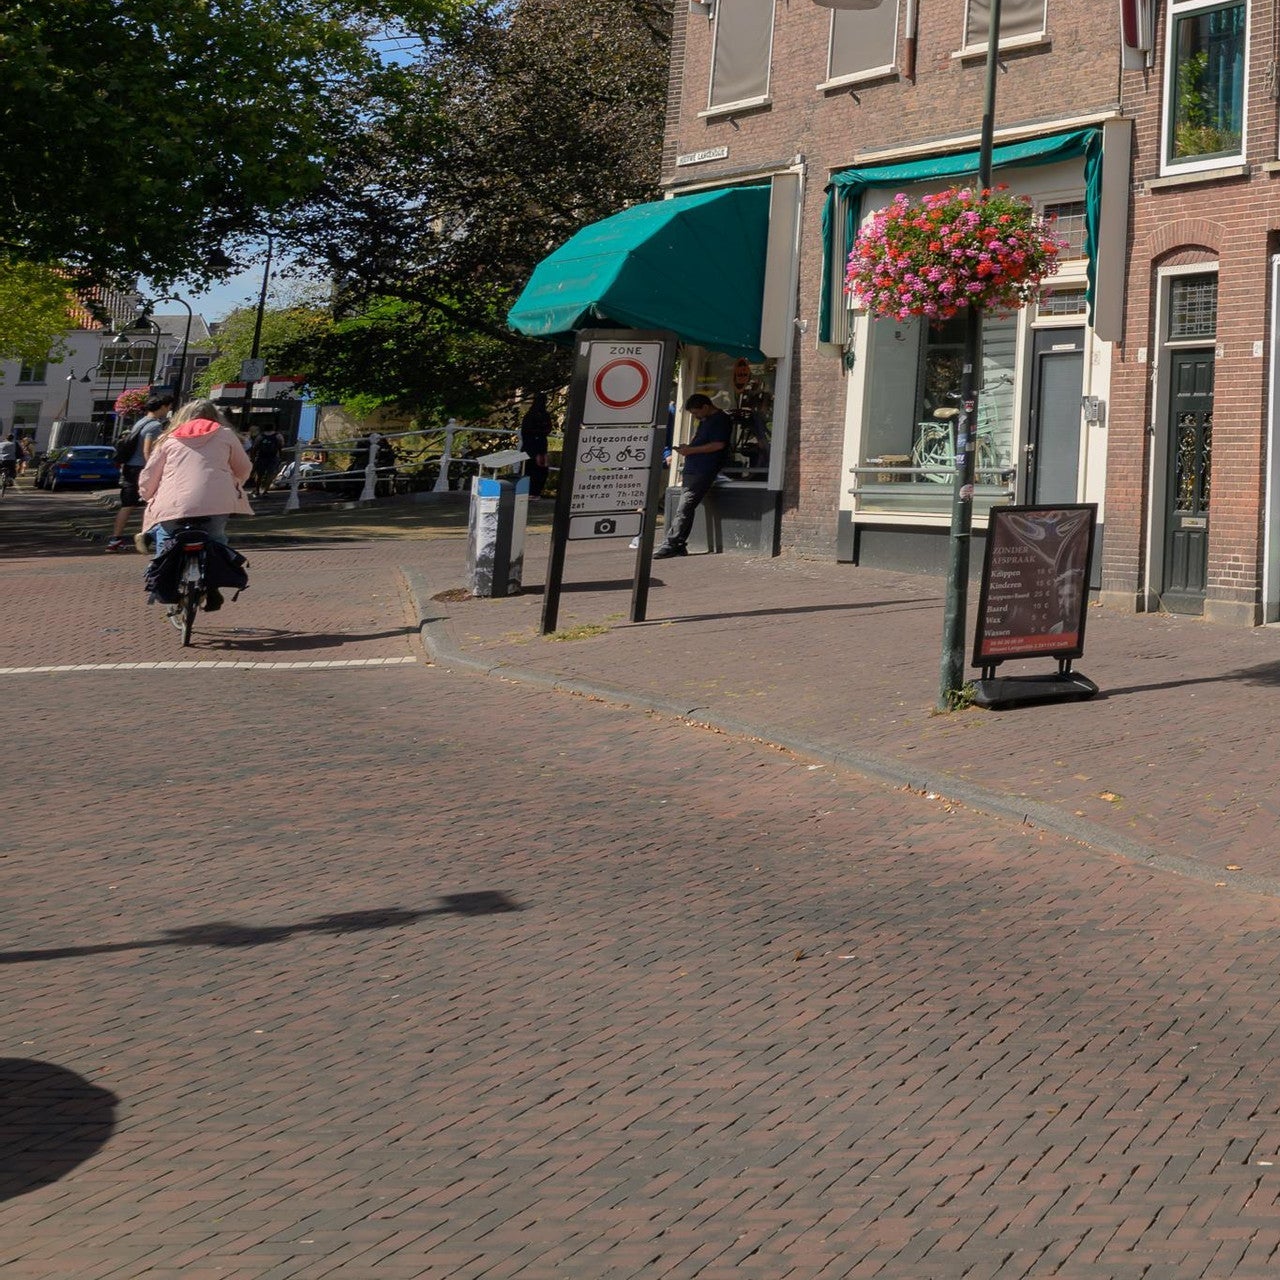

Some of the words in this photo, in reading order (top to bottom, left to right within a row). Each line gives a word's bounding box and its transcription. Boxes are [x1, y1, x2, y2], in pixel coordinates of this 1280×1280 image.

[609, 346, 643, 356] ZONE
[582, 434, 650, 445] uitgezonderd
[588, 473, 634, 481] toegestaan
[578, 483, 601, 491] laden
[616, 490, 645, 498] 7h-12h
[990, 581, 1022, 590] Kinderen
[987, 605, 1008, 613] Baard
[984, 629, 1011, 637] Wassen
